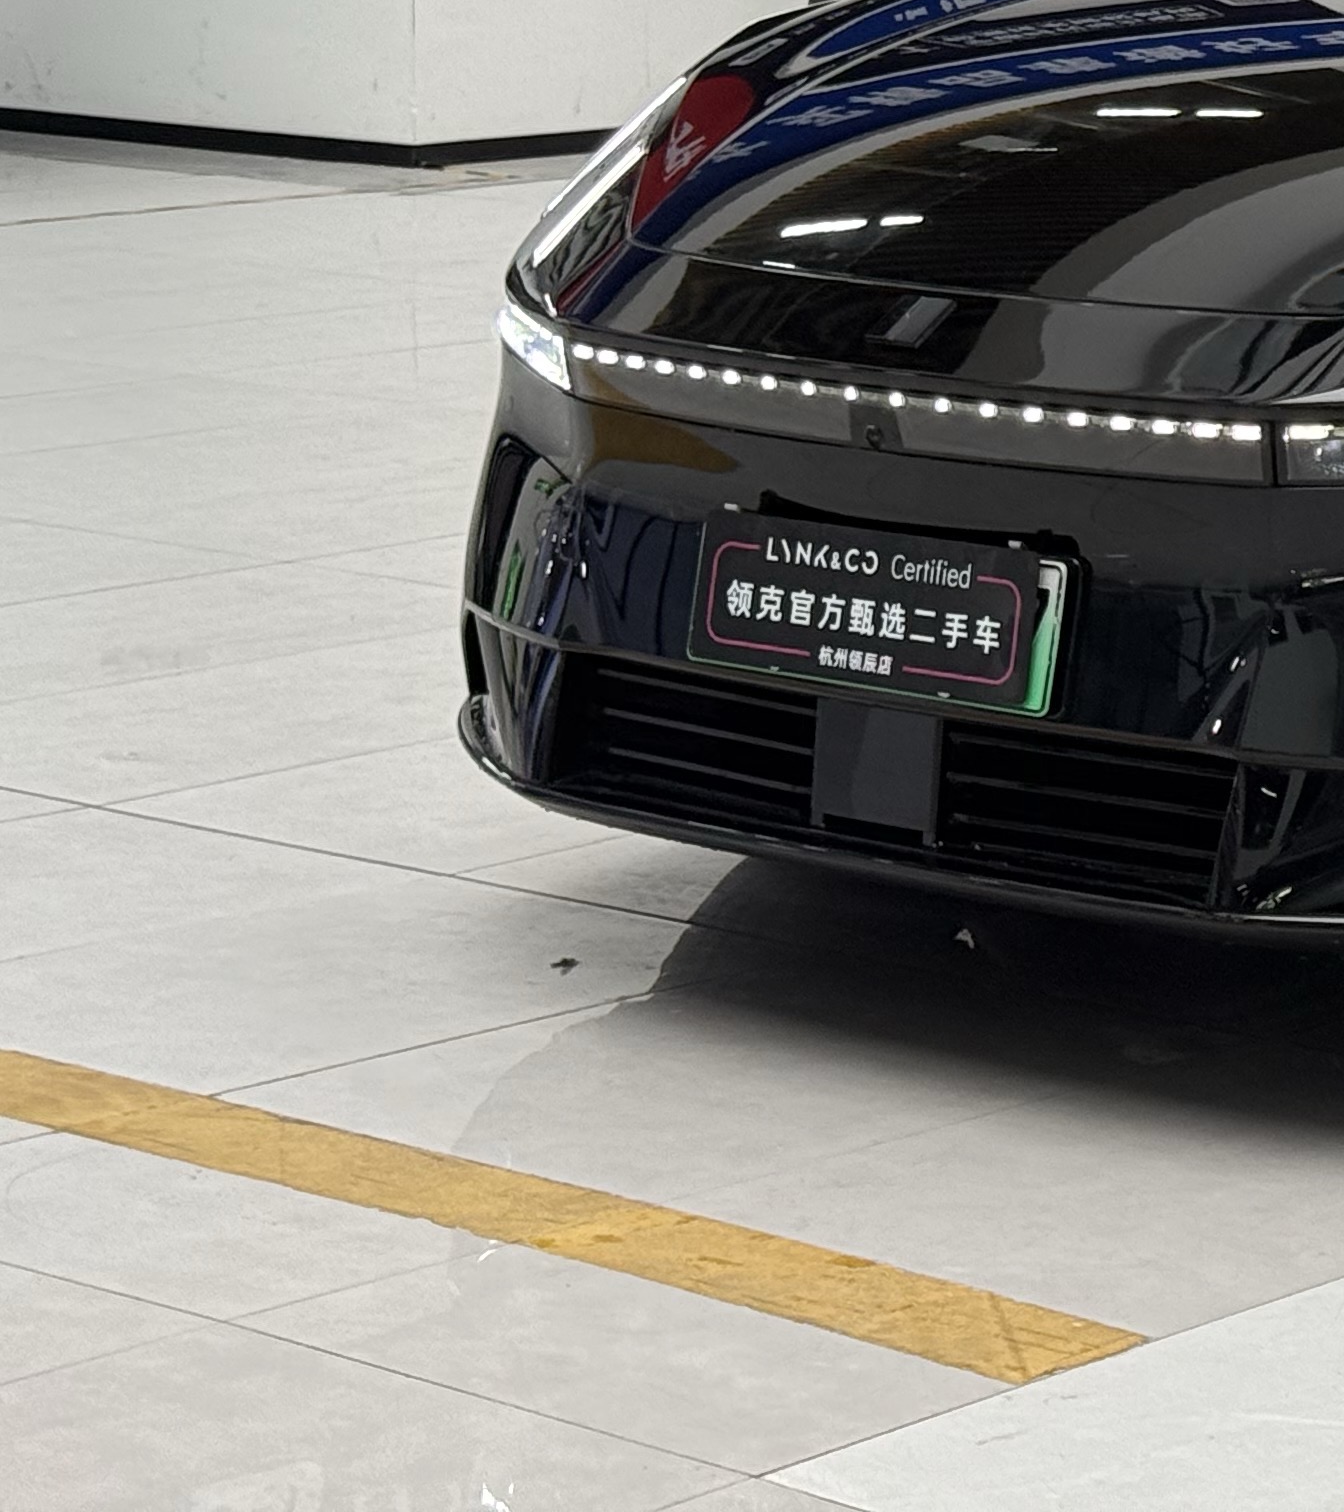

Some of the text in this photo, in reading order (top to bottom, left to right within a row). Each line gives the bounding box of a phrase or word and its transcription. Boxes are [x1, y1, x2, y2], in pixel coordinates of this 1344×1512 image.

[766, 536, 973, 589] LYNK&CO Certified
[726, 578, 1002, 655] 领克官方甄选二手车
